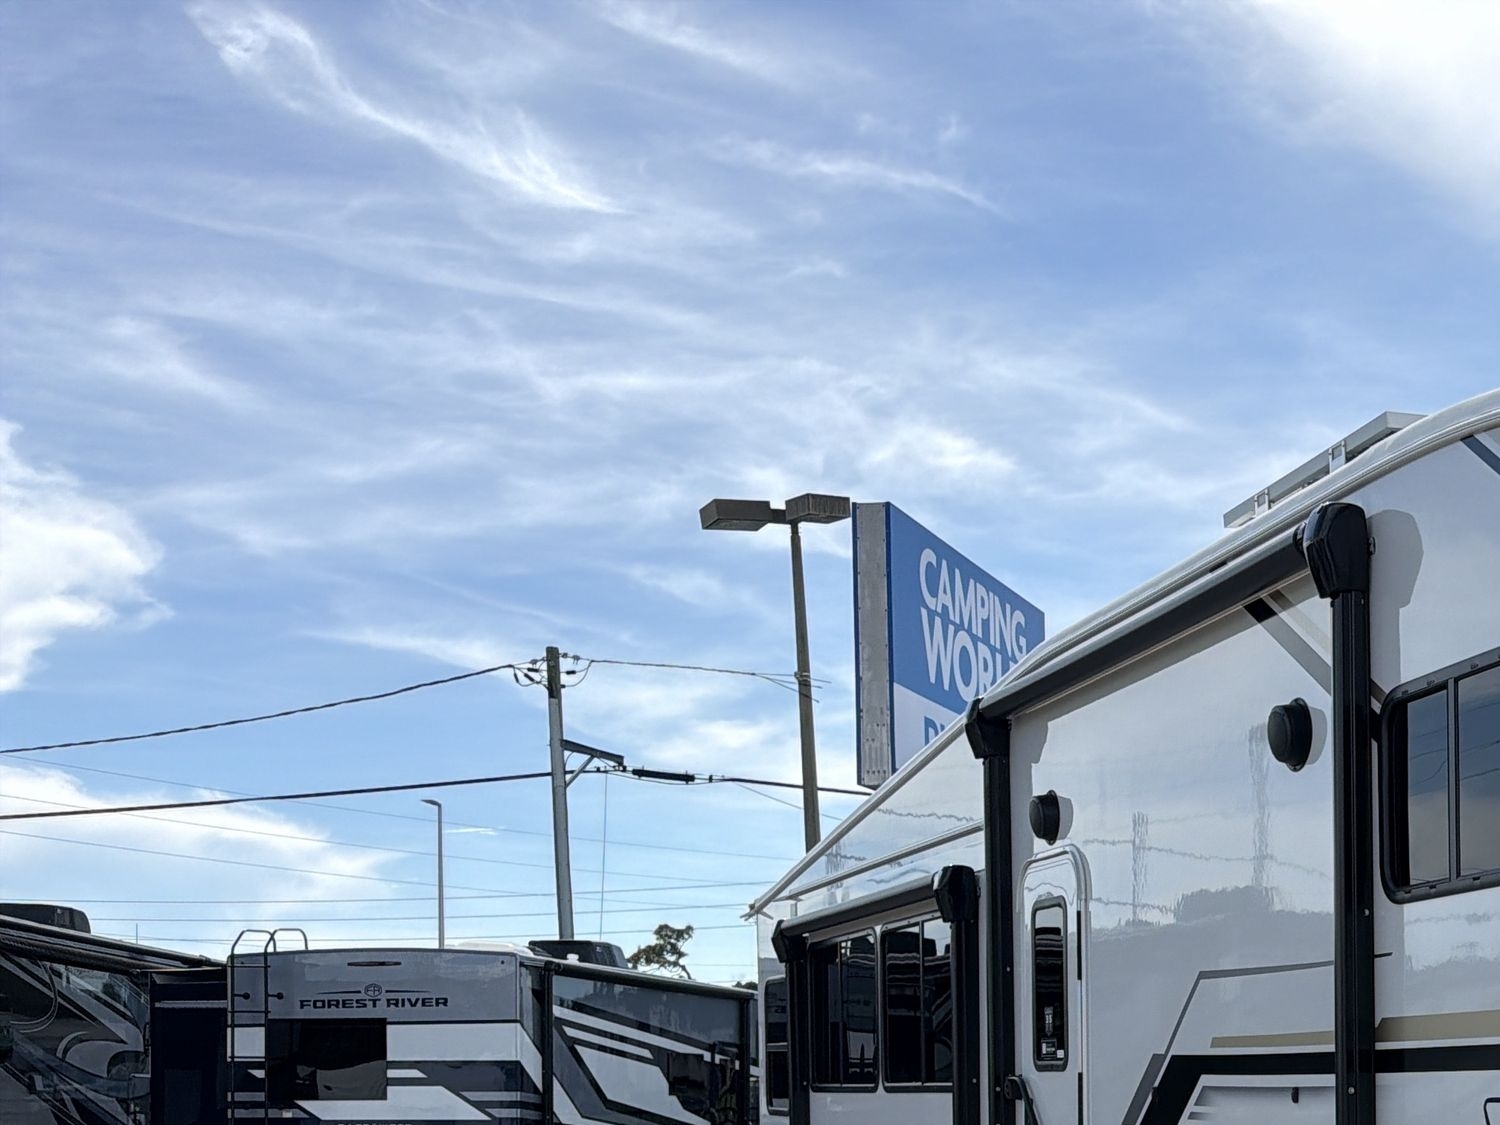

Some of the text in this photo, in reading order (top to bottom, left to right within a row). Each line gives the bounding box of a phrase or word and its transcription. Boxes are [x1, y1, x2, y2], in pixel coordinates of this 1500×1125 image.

[919, 548, 1027, 662] CAMPING
[920, 606, 1015, 703] WOR
[299, 997, 449, 1010] FOREST RIVER
